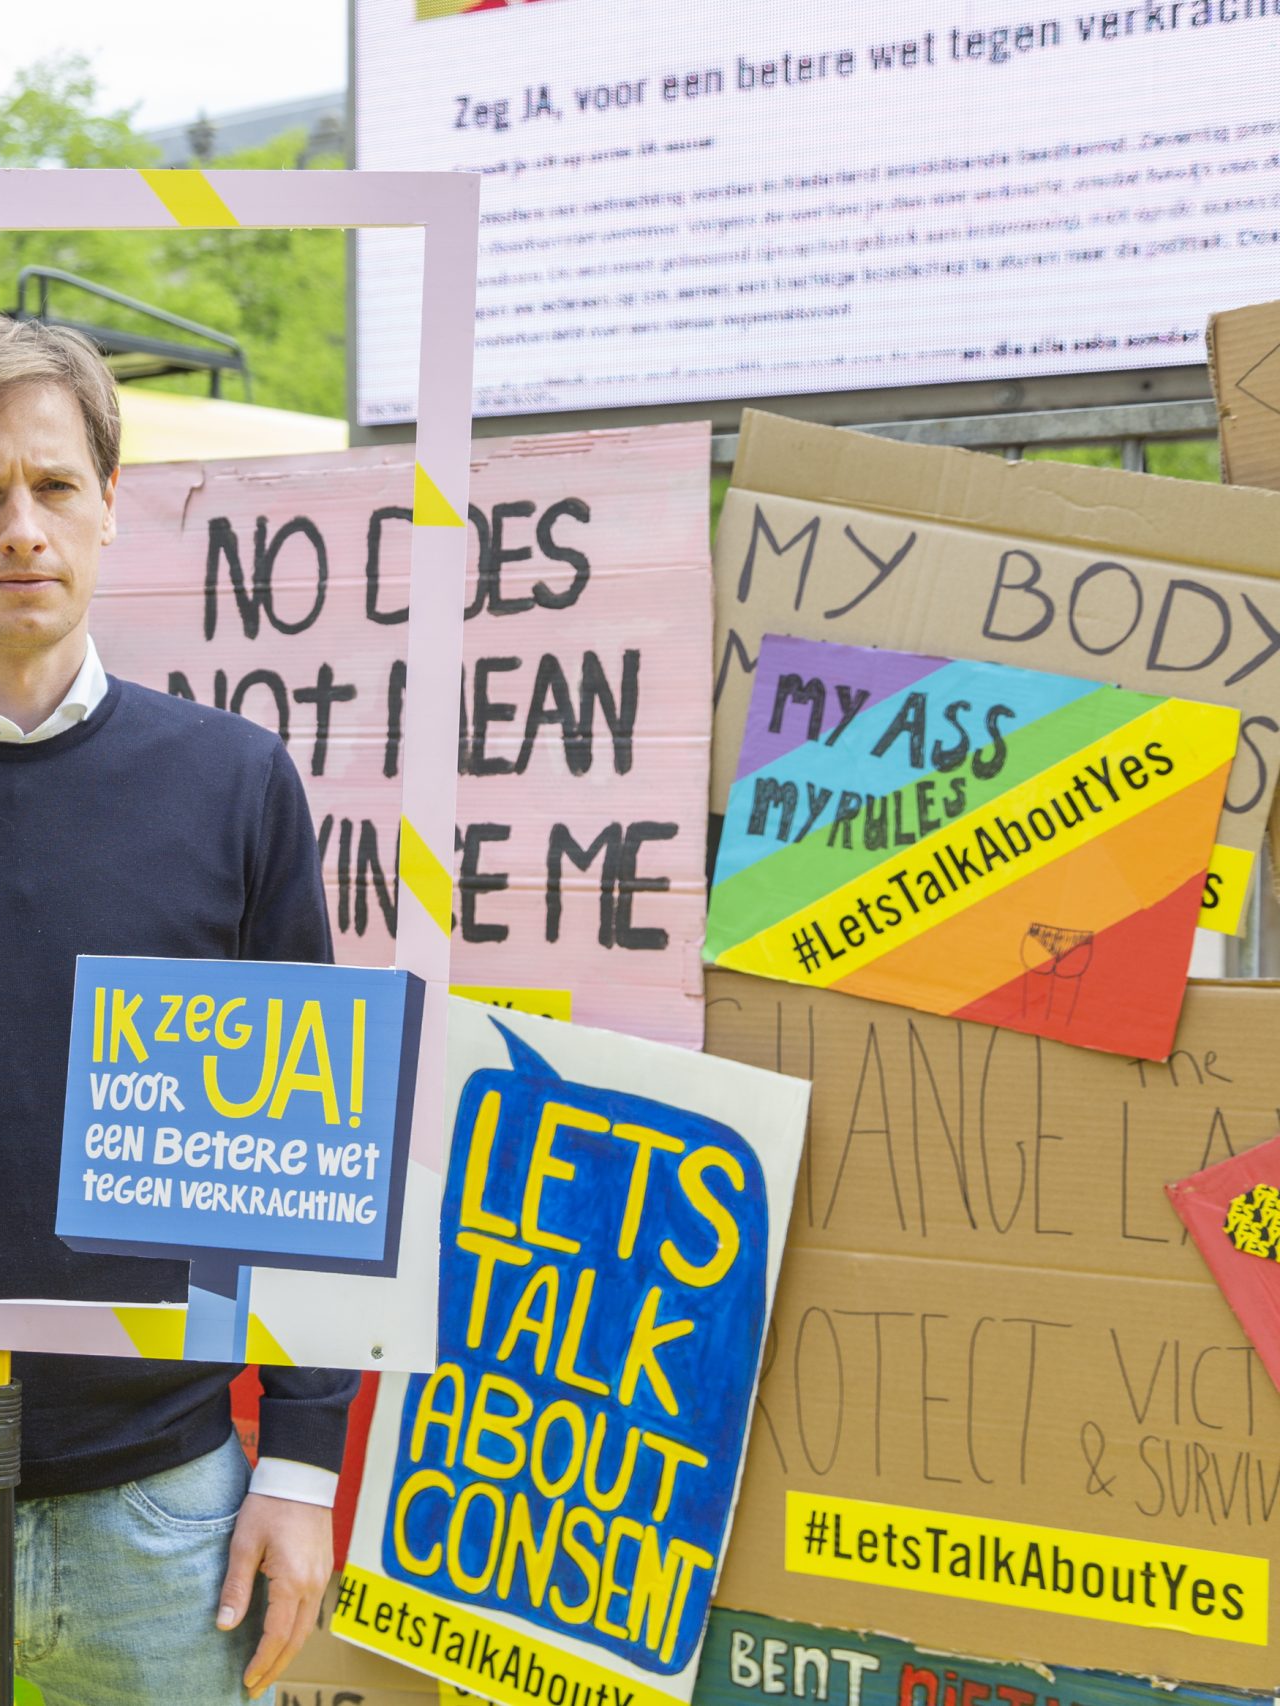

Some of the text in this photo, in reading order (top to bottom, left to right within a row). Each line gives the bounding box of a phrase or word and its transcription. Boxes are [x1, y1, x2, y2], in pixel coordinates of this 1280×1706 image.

[453, 94, 509, 132] Zeg
[576, 77, 646, 113] voor
[662, 66, 723, 101] een
[736, 44, 854, 93] betere
[869, 31, 934, 72] wet
[951, 15, 1061, 66] tegen
[203, 516, 327, 641] NO
[737, 502, 918, 620] MY
[768, 673, 1017, 781] MY ASS
[545, 820, 680, 950] ME
[792, 740, 1175, 975] #LetsTalkAboutYes
[92, 987, 150, 1063] IK
[203, 998, 366, 1129] JA!
[459, 1090, 746, 1288] LETS
[456, 1230, 695, 1417] TALK
[410, 1361, 709, 1522] ABOUT
[393, 1468, 714, 1665] CONSENT
[804, 1509, 1245, 1622] #LetsTalkAboutYes
